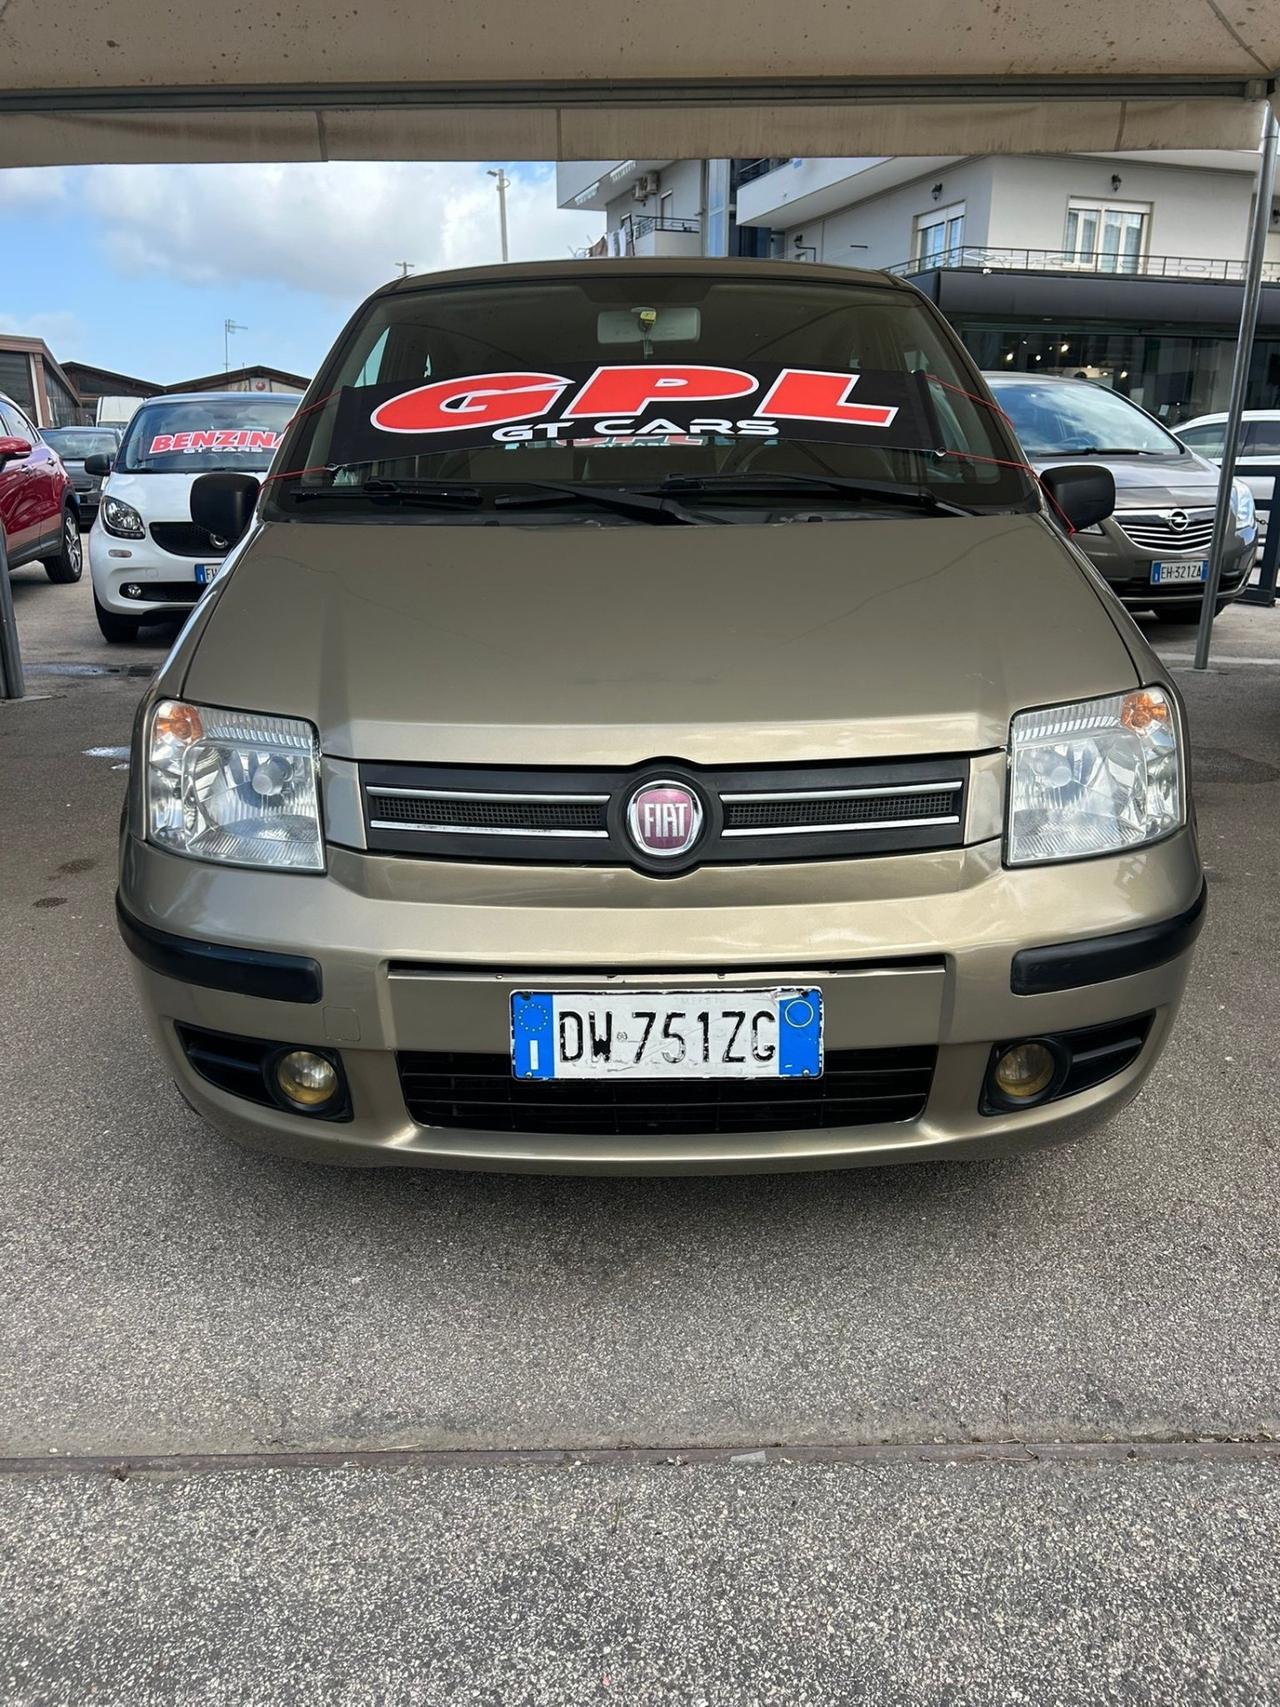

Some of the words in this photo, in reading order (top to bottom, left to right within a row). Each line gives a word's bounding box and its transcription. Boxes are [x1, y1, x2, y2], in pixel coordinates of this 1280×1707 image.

[370, 364, 899, 434] GPL
[492, 421, 575, 441] GT
[593, 418, 780, 436] CARS
[643, 803, 688, 838] FIAT
